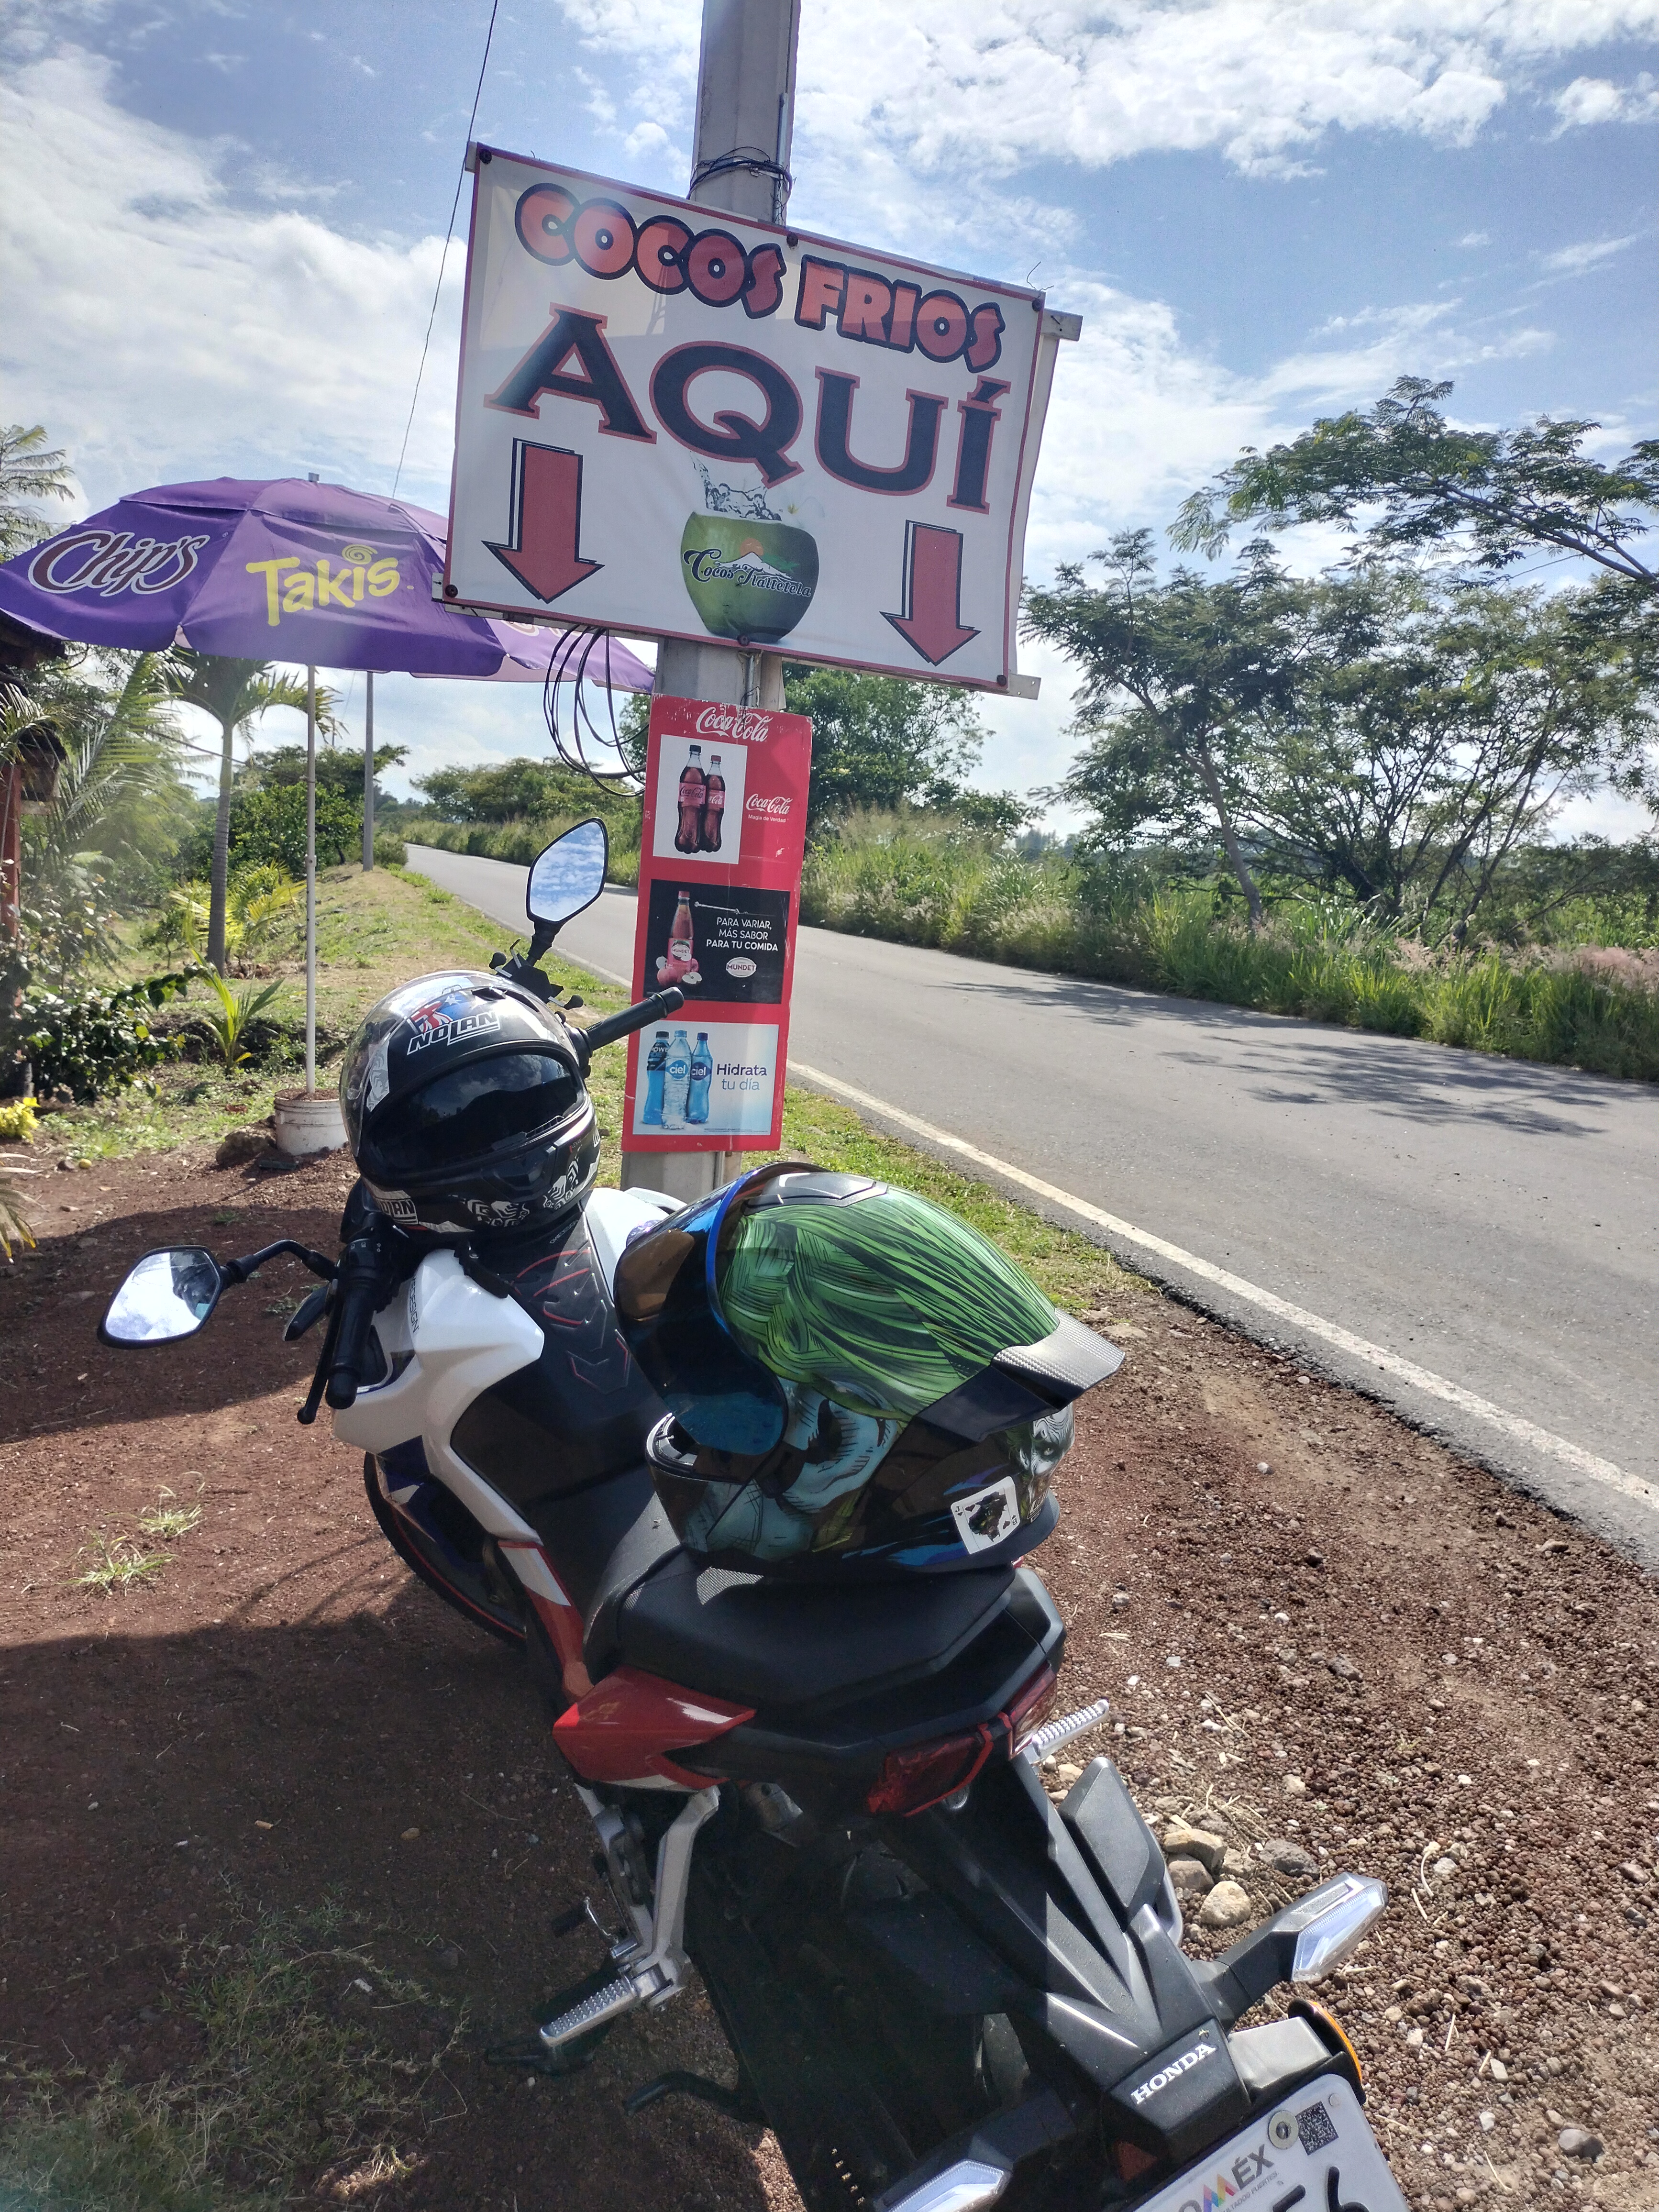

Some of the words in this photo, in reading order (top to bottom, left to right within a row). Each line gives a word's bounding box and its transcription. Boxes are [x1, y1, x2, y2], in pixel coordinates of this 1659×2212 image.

[515, 182, 787, 319] COCOS
[795, 254, 1006, 373] FRIOS
[484, 302, 1010, 514] AQUÍ
[28, 530, 210, 597] Chip's
[684, 548, 734, 583] Cocos
[738, 564, 812, 597] Tlaltetela
[246, 544, 400, 626] Takis
[717, 917, 739, 927] PARA
[741, 919, 772, 930] VARIAR,
[719, 928, 738, 938] MÁS
[740, 930, 768, 940] SABOR
[706, 939, 729, 949] PARA
[731, 941, 742, 949] TU
[744, 941, 778, 951] COMIDA
[727, 963, 756, 972] MUNDET
[407, 1011, 500, 1055] NOLAN
[670, 1063, 686, 1074] ciel
[691, 1065, 707, 1076] ciel
[717, 1063, 768, 1076] Hidrata
[721, 1079, 735, 1090] tu
[739, 1078, 760, 1091] día
[1131, 2043, 1217, 2105] HONDA
